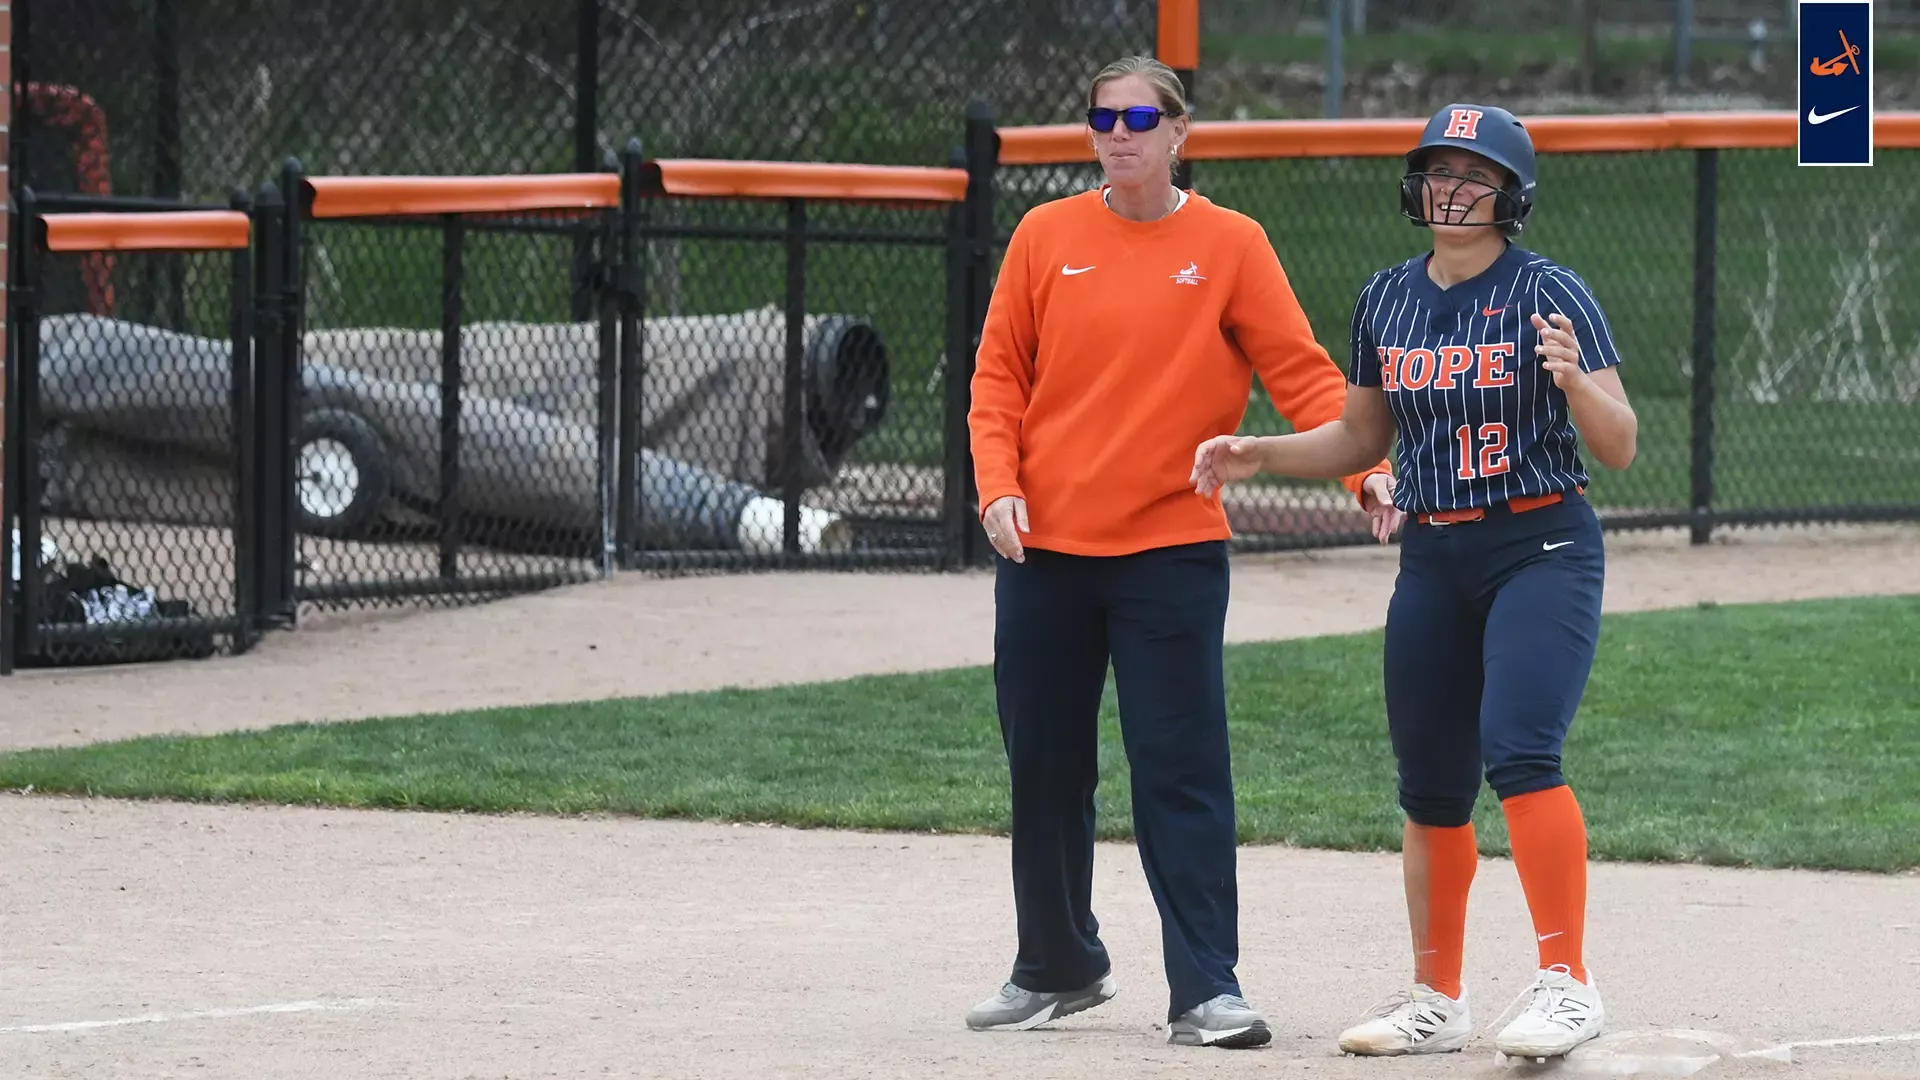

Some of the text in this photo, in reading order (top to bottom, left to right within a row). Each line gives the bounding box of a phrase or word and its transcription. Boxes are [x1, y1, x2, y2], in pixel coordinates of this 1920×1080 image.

[1444, 109, 1483, 140] H
[1175, 277, 1199, 285] SOFTBALL
[1377, 342, 1515, 392] HOPE
[1456, 422, 1511, 480] 12
